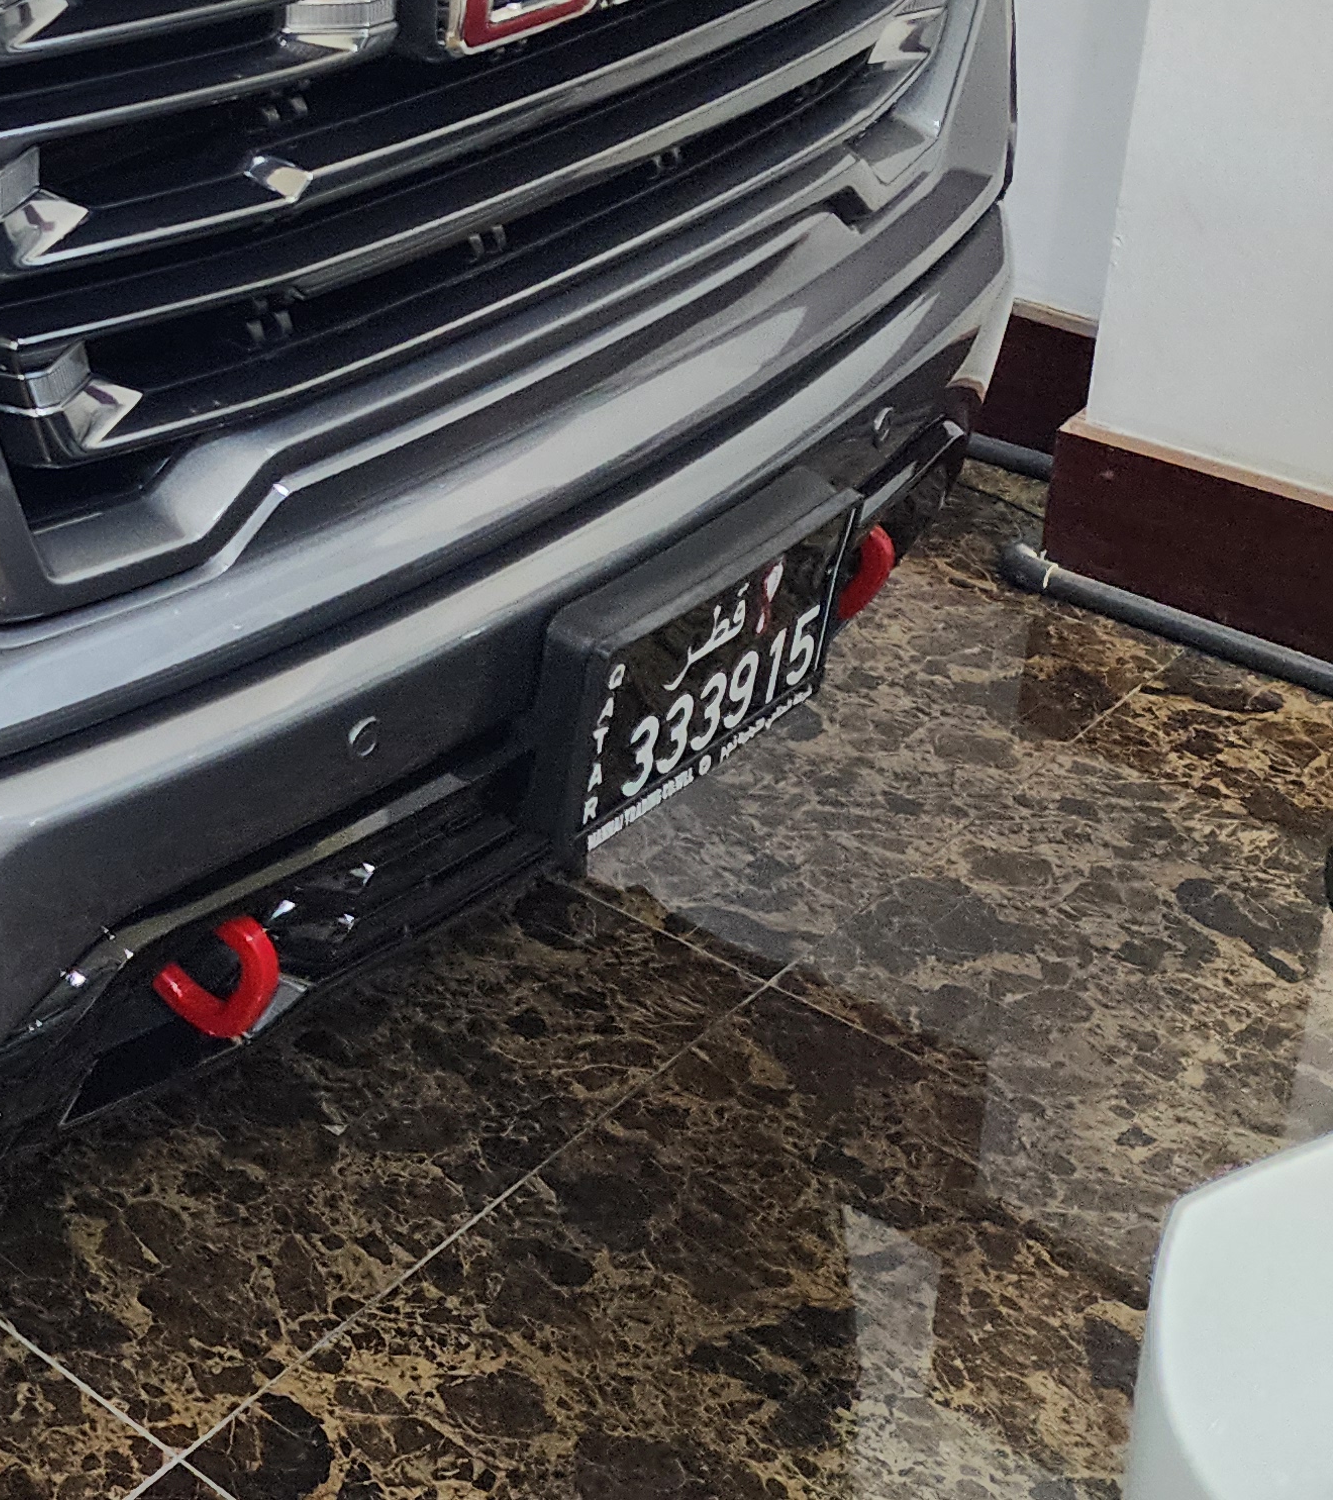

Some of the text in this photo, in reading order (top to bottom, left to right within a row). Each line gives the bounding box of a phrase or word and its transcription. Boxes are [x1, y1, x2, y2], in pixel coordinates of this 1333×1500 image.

[620, 603, 821, 798] 333915
[663, 582, 750, 691] قطر
[582, 662, 625, 826] QATAR
